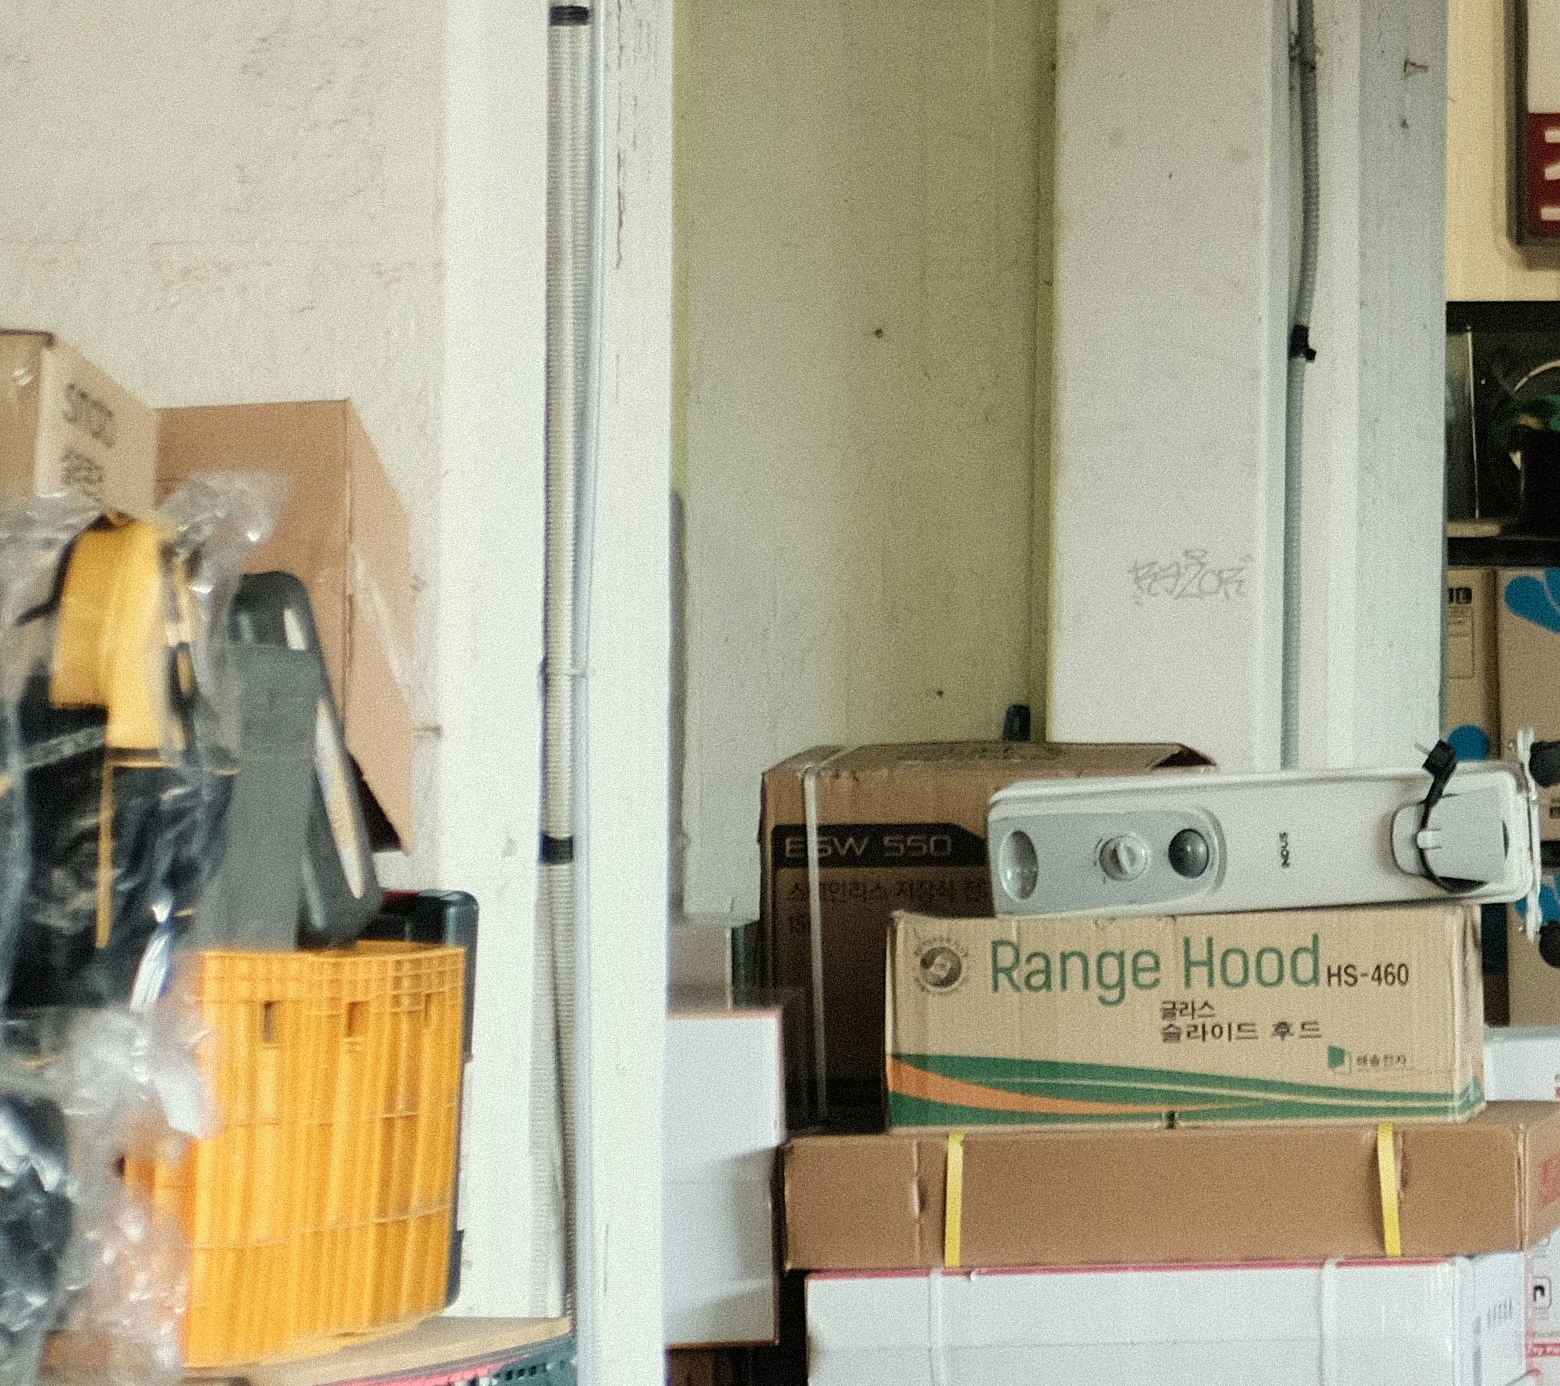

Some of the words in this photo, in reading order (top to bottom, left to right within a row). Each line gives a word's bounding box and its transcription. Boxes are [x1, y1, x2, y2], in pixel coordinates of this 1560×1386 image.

[883, 834, 953, 858] 550
[990, 939, 1162, 1006] Range
[1183, 934, 1322, 991] Hood
[1326, 962, 1410, 988] HS-460
[1161, 1000, 1216, 1021] 글라스
[1162, 1022, 1259, 1043] 슬라이드
[1270, 1020, 1323, 1042] 후드
